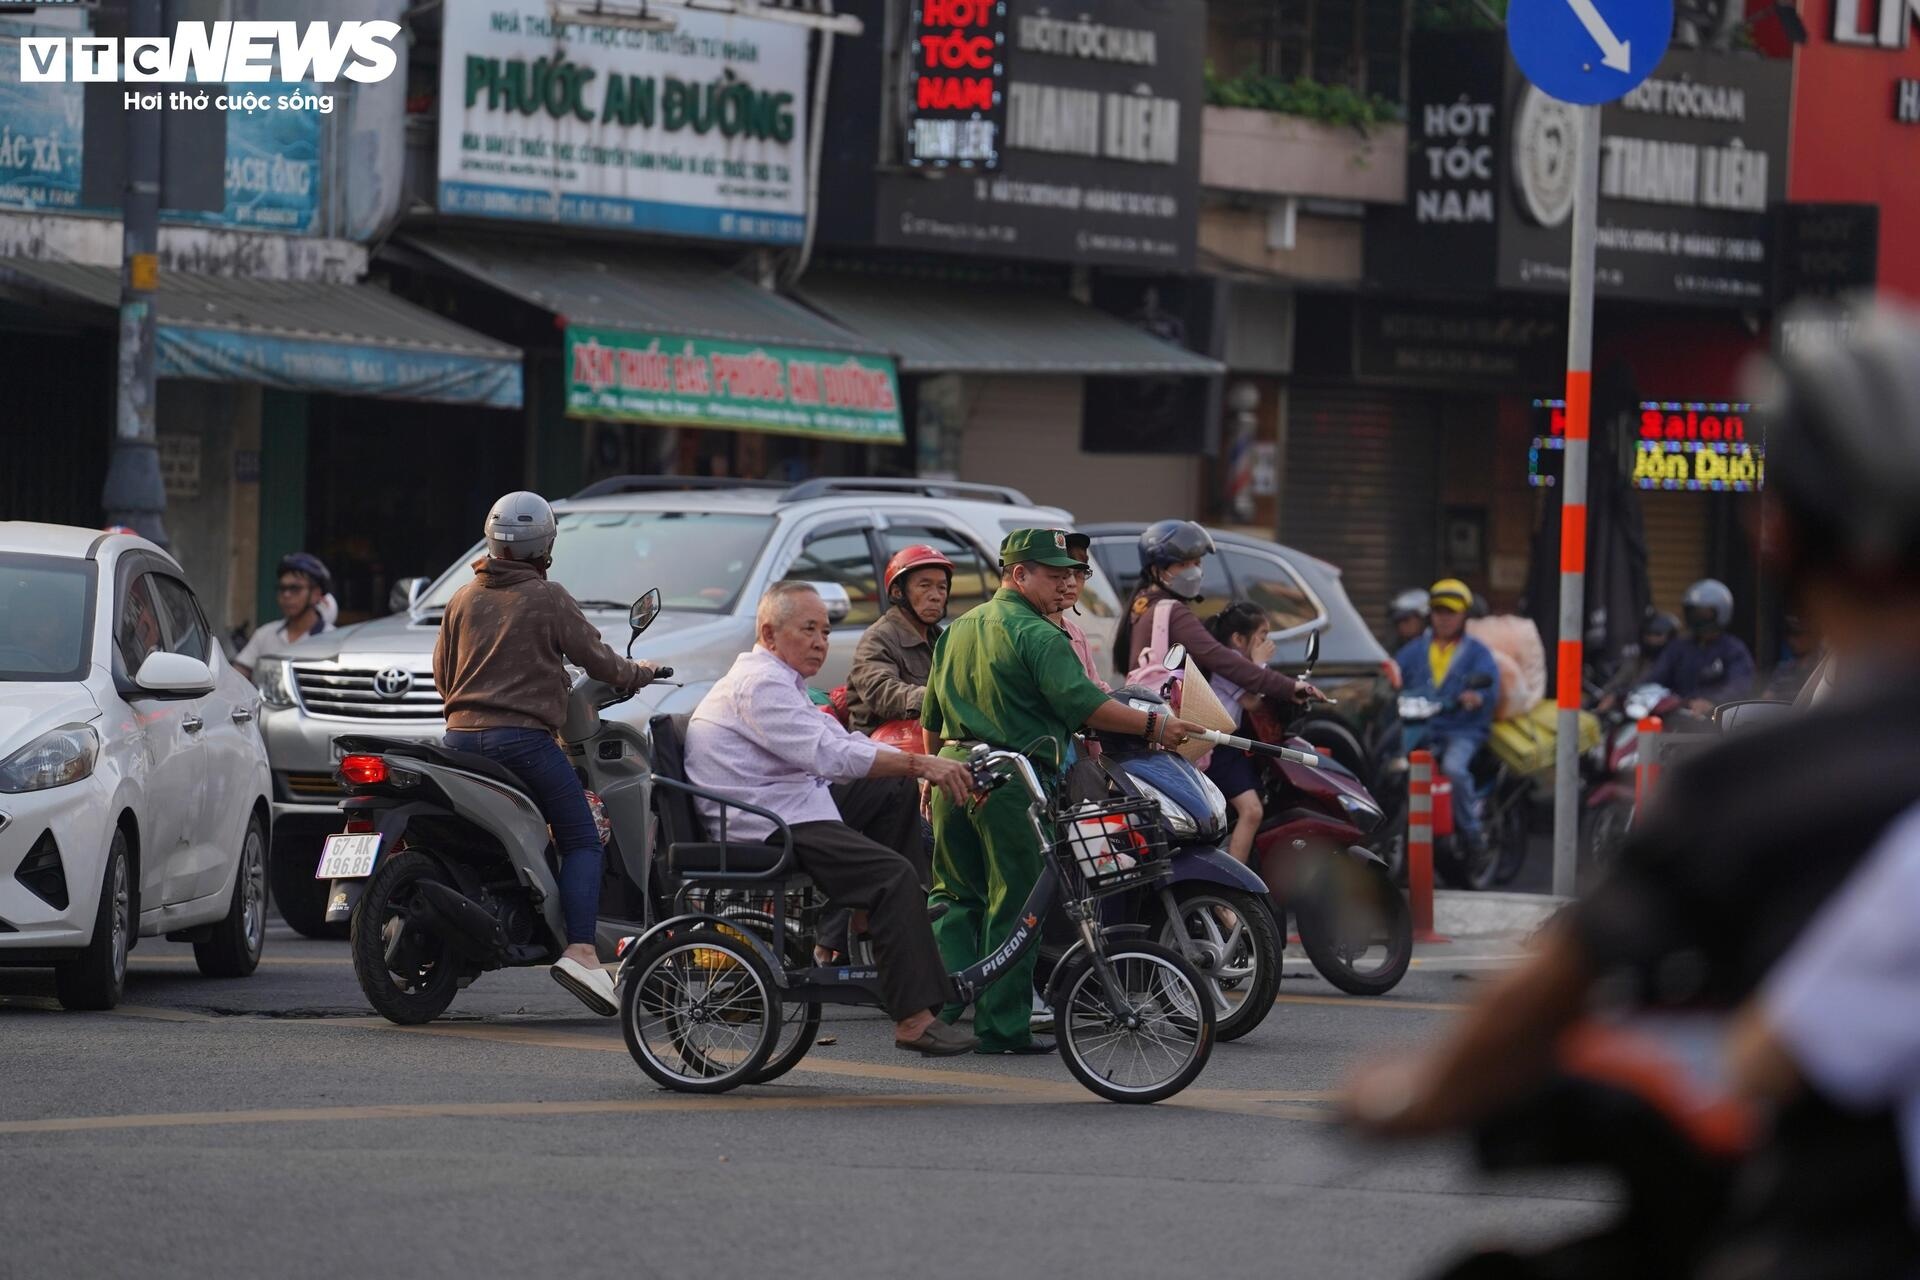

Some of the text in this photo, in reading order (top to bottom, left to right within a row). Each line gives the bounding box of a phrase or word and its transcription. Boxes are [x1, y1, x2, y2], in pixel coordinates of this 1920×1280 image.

[920, 28, 994, 69] TÓC
[464, 48, 796, 146] PHƯỚC AN ĐƯỜNG
[917, 76, 994, 110] NAM
[1416, 189, 1494, 223] NAM
[1640, 409, 1744, 439] Salon
[332, 837, 373, 856] 67-AK
[325, 857, 371, 876] 196.86
[981, 926, 1028, 977] PIGEON
